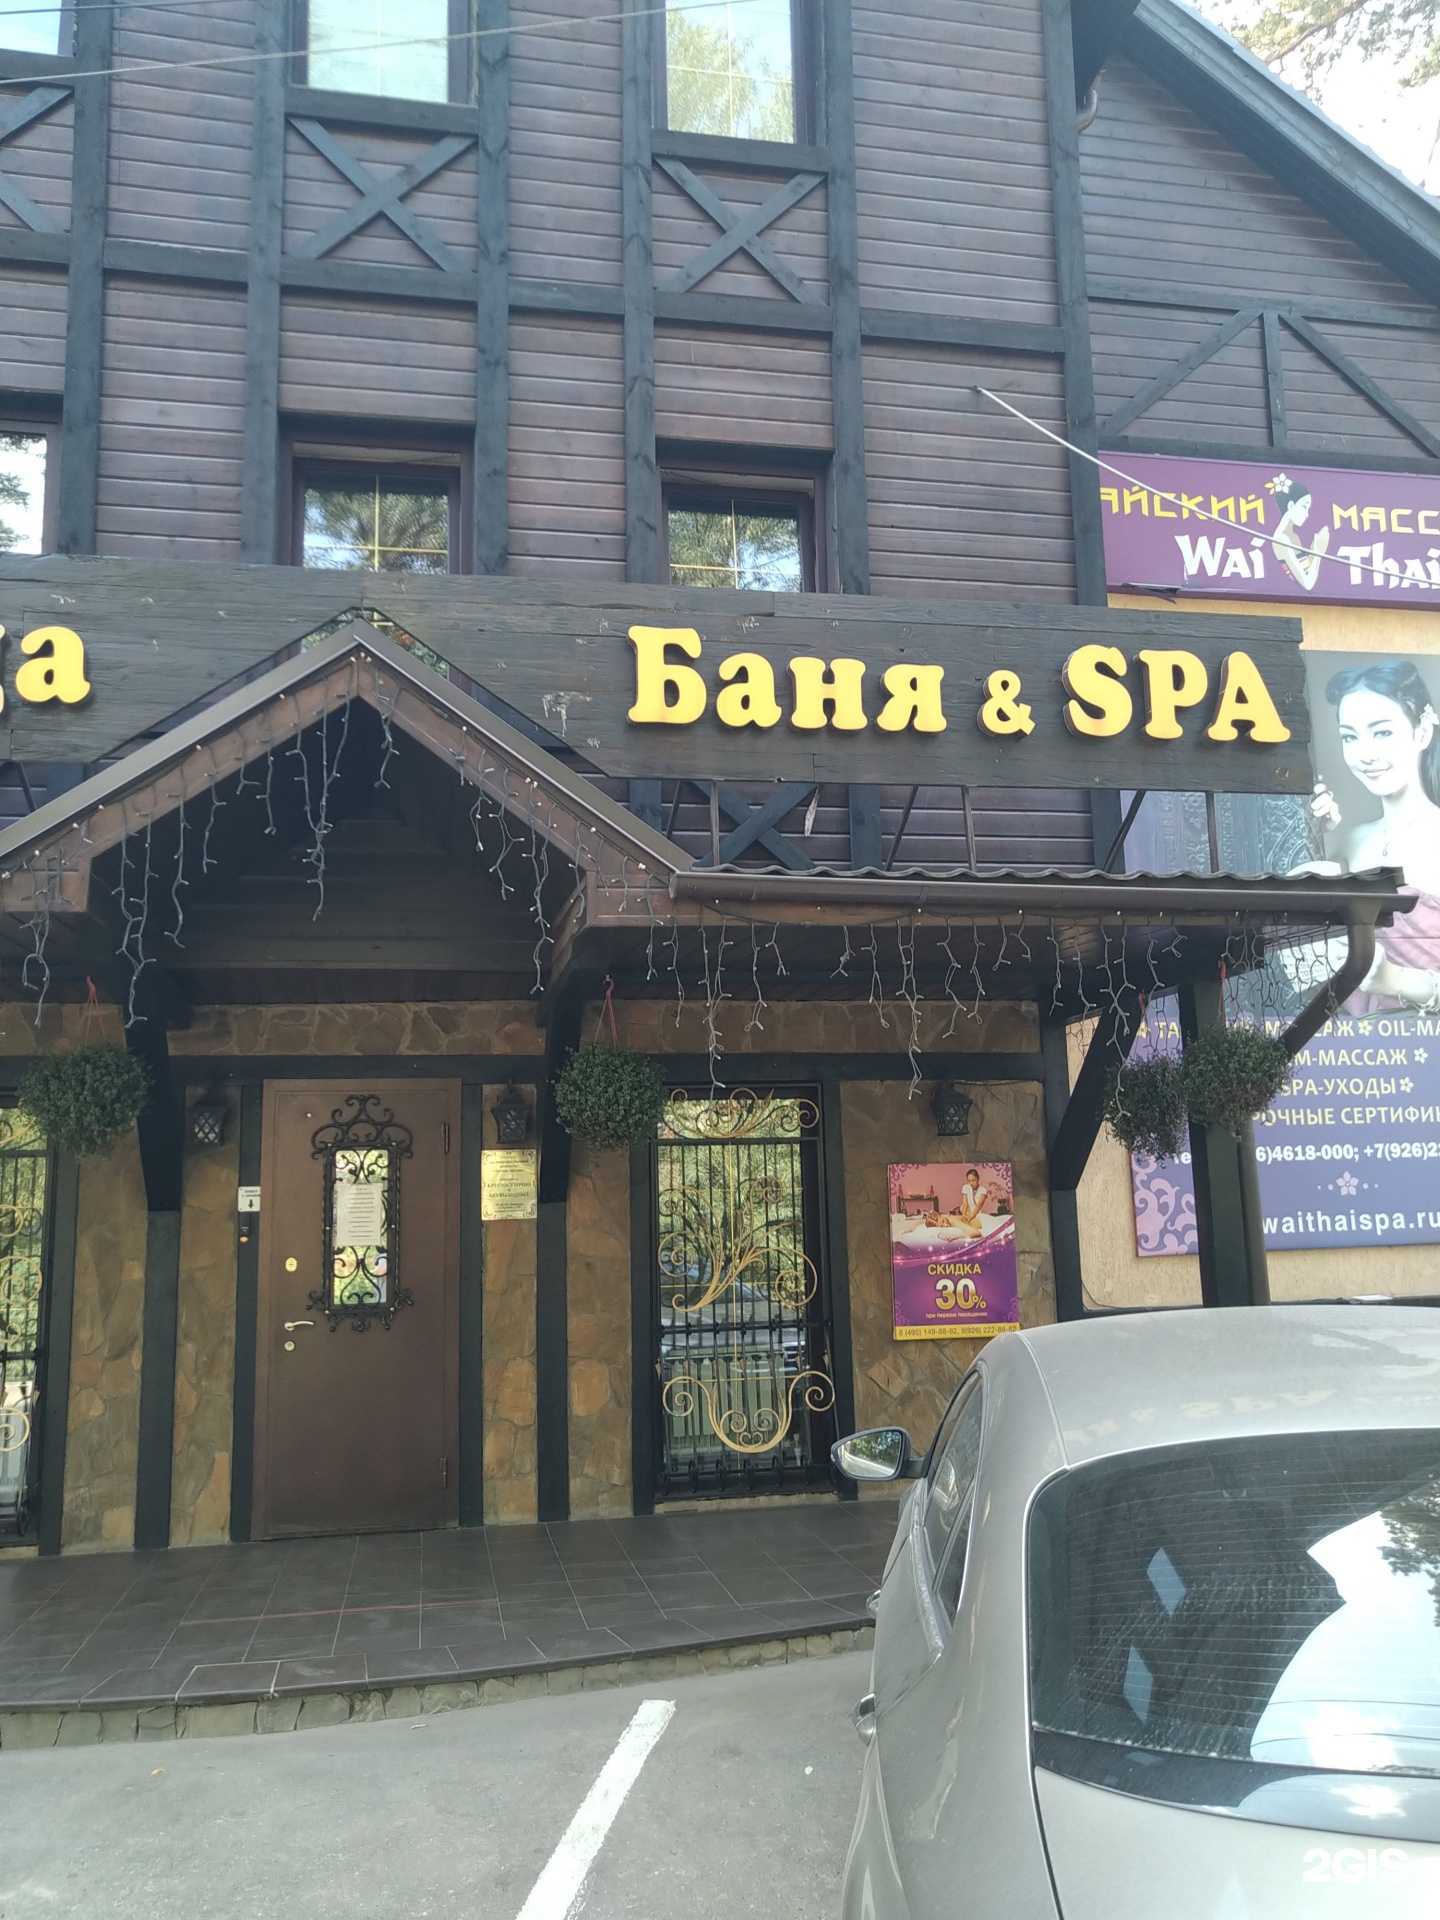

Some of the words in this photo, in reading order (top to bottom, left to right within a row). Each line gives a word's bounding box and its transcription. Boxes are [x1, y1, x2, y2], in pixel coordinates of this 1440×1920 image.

[1332, 503, 1440, 535] МАСС
[627, 625, 948, 735] Баня
[977, 669, 1036, 737] &
[1061, 644, 1292, 744] SPA
[1363, 1142, 1440, 1162] +7(926)2
[927, 1263, 982, 1276] СКИДКА
[935, 1278, 987, 1310] 30%
